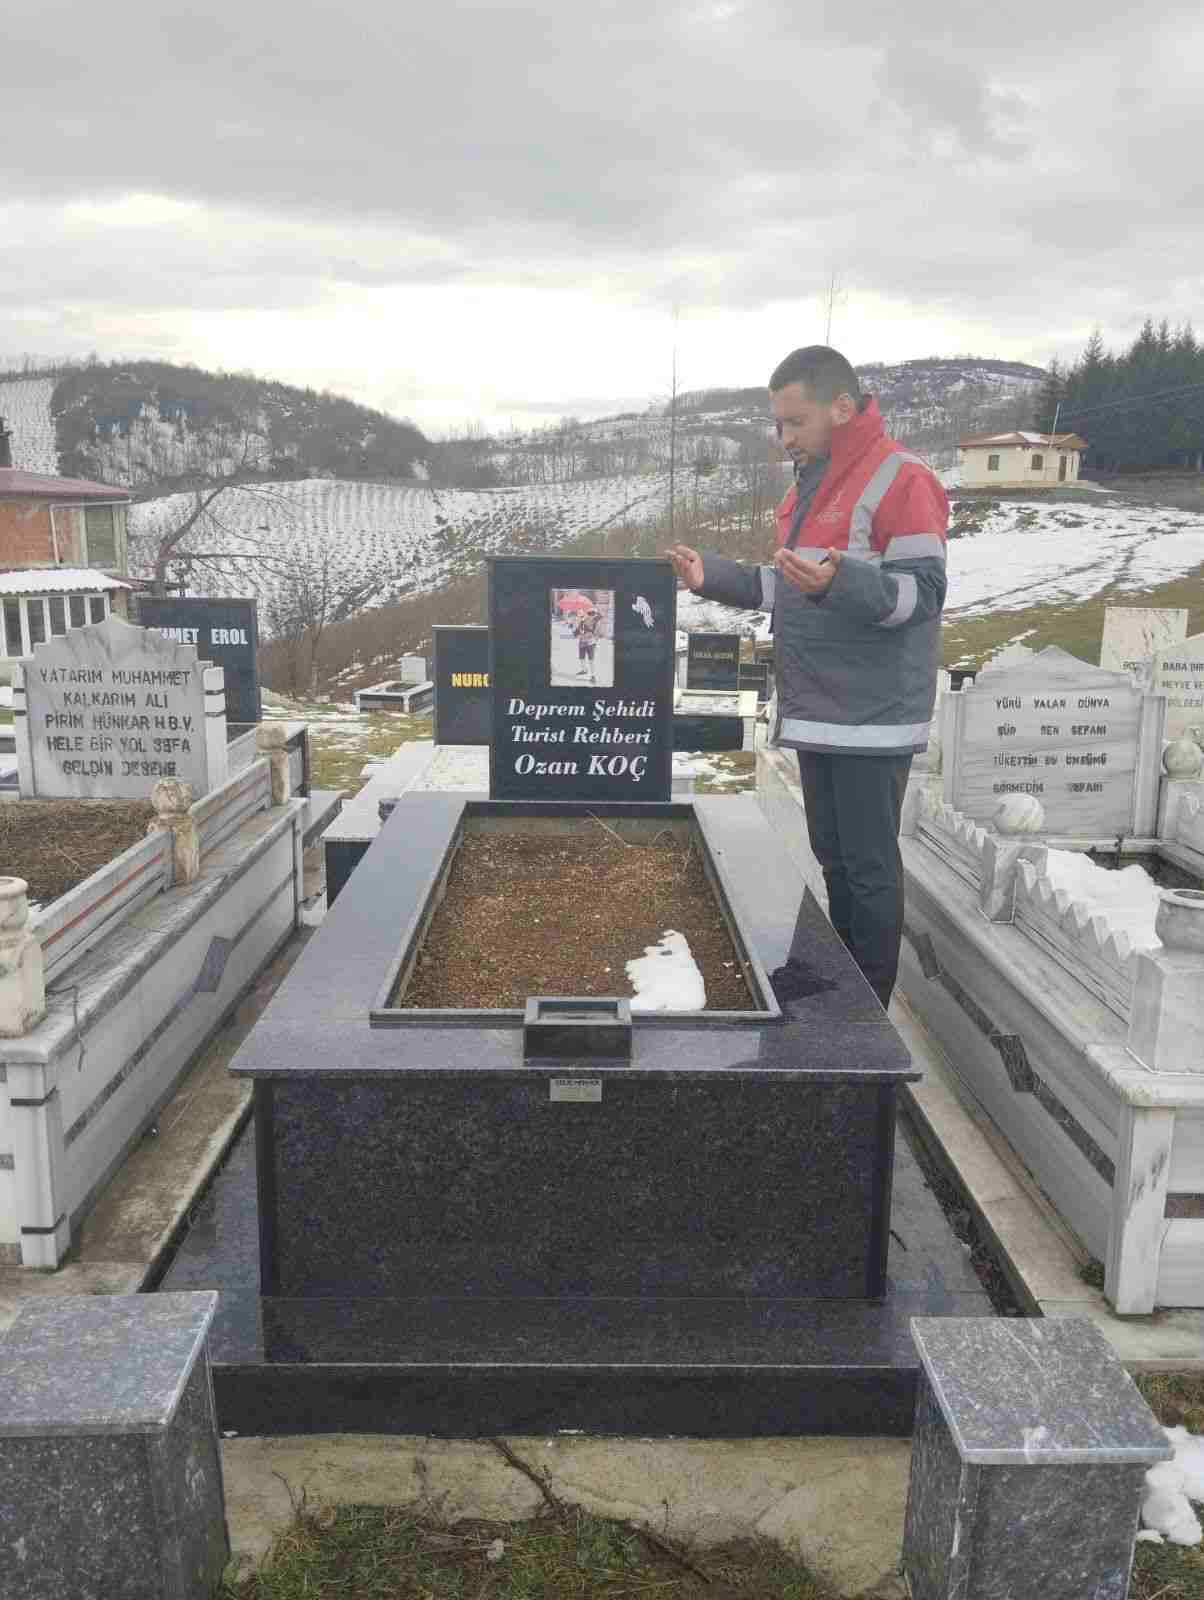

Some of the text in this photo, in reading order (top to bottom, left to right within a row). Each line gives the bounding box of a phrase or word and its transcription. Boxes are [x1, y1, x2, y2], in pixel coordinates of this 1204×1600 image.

[211, 628, 248, 645] EROL
[40, 668, 191, 686] YATARIM MUHAMMET
[63, 692, 136, 707] KALKARIM
[1034, 699, 1066, 709] YALAN
[1078, 697, 1109, 709] DÜNYA
[507, 698, 656, 721] Deprem Şehidi
[45, 712, 84, 729] PİRİM
[93, 713, 150, 731] HÜNKAR
[511, 725, 651, 744] Turist Rehberi
[47, 735, 191, 753] HELE BİR YOL SEFA
[514, 753, 648, 782] Ozan KOÇ
